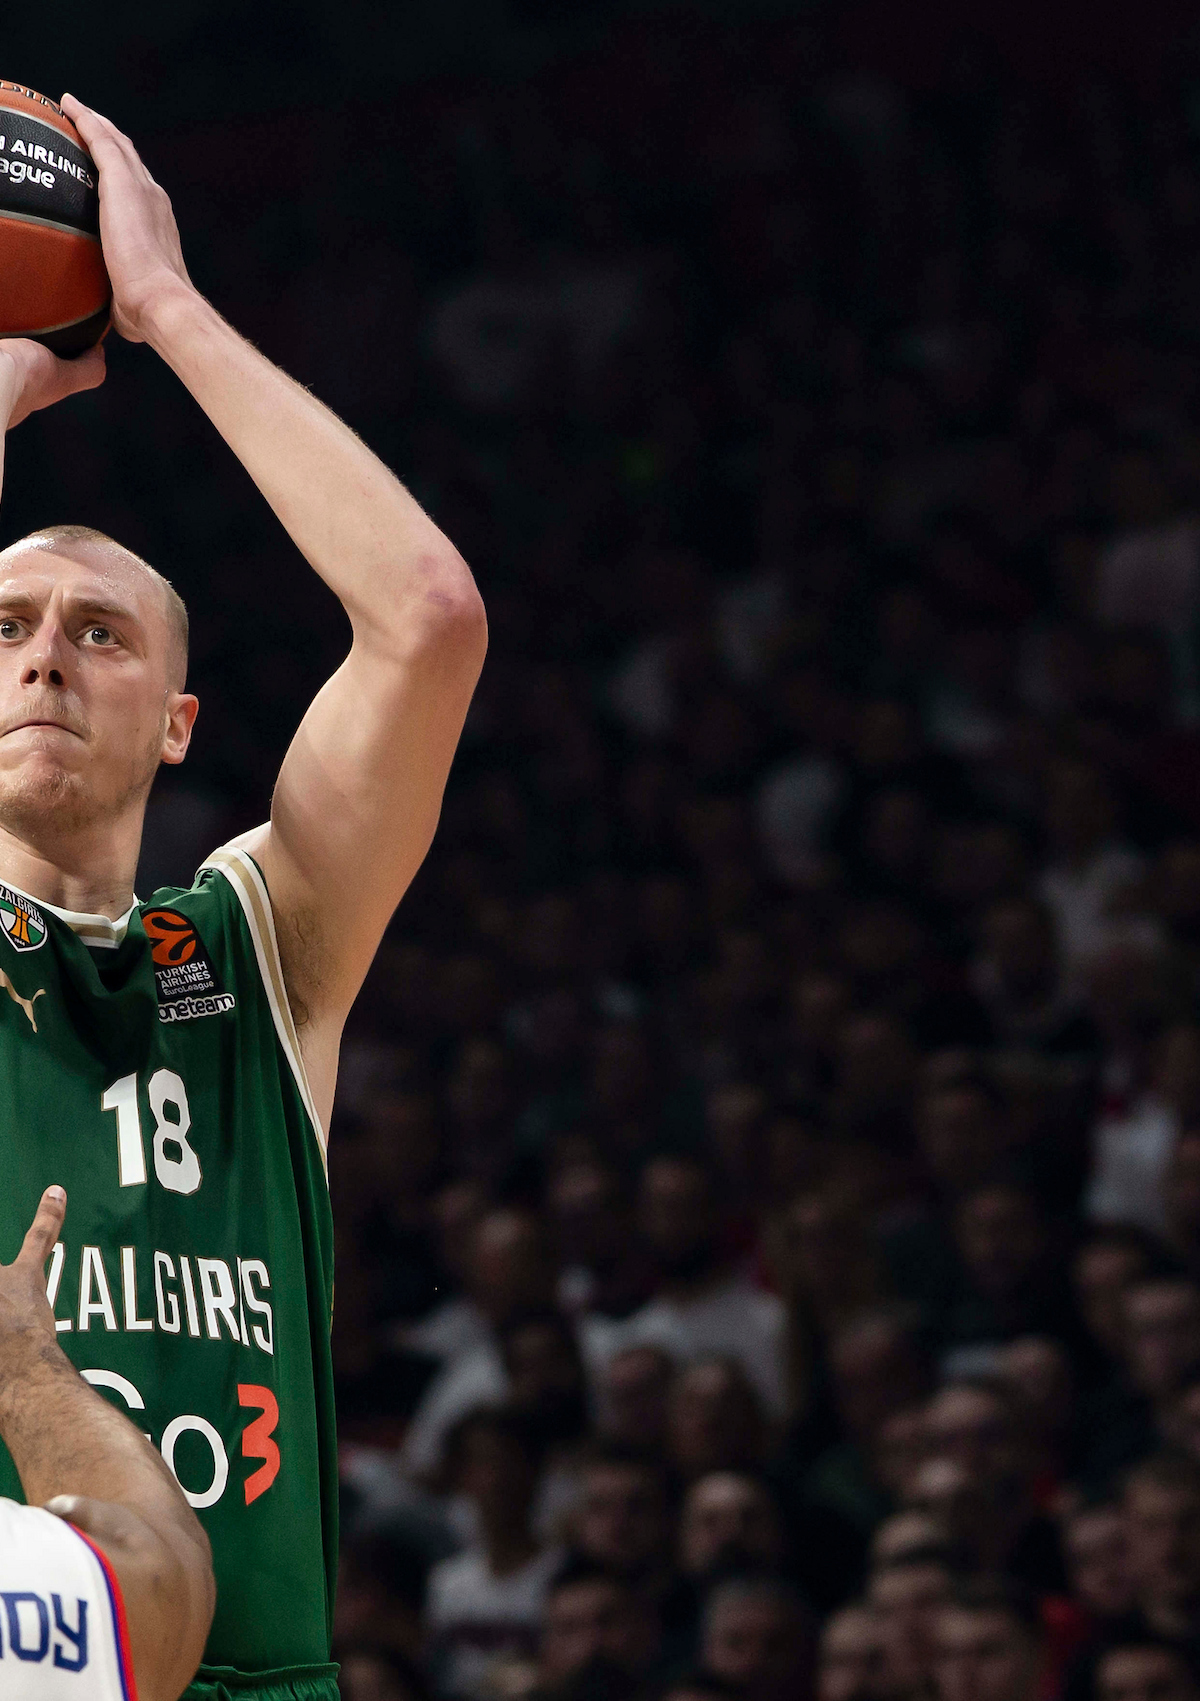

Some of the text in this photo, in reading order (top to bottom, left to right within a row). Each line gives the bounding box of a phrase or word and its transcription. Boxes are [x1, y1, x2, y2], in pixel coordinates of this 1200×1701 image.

[11, 139, 94, 189] AIRLINES
[155, 961, 208, 981] TURKISH
[161, 970, 211, 989] AIRLINES
[162, 980, 215, 996] EuroLeague
[158, 993, 236, 1023] oneteam
[101, 1066, 203, 1196] 18
[46, 1240, 275, 1356] ZALGIRIS
